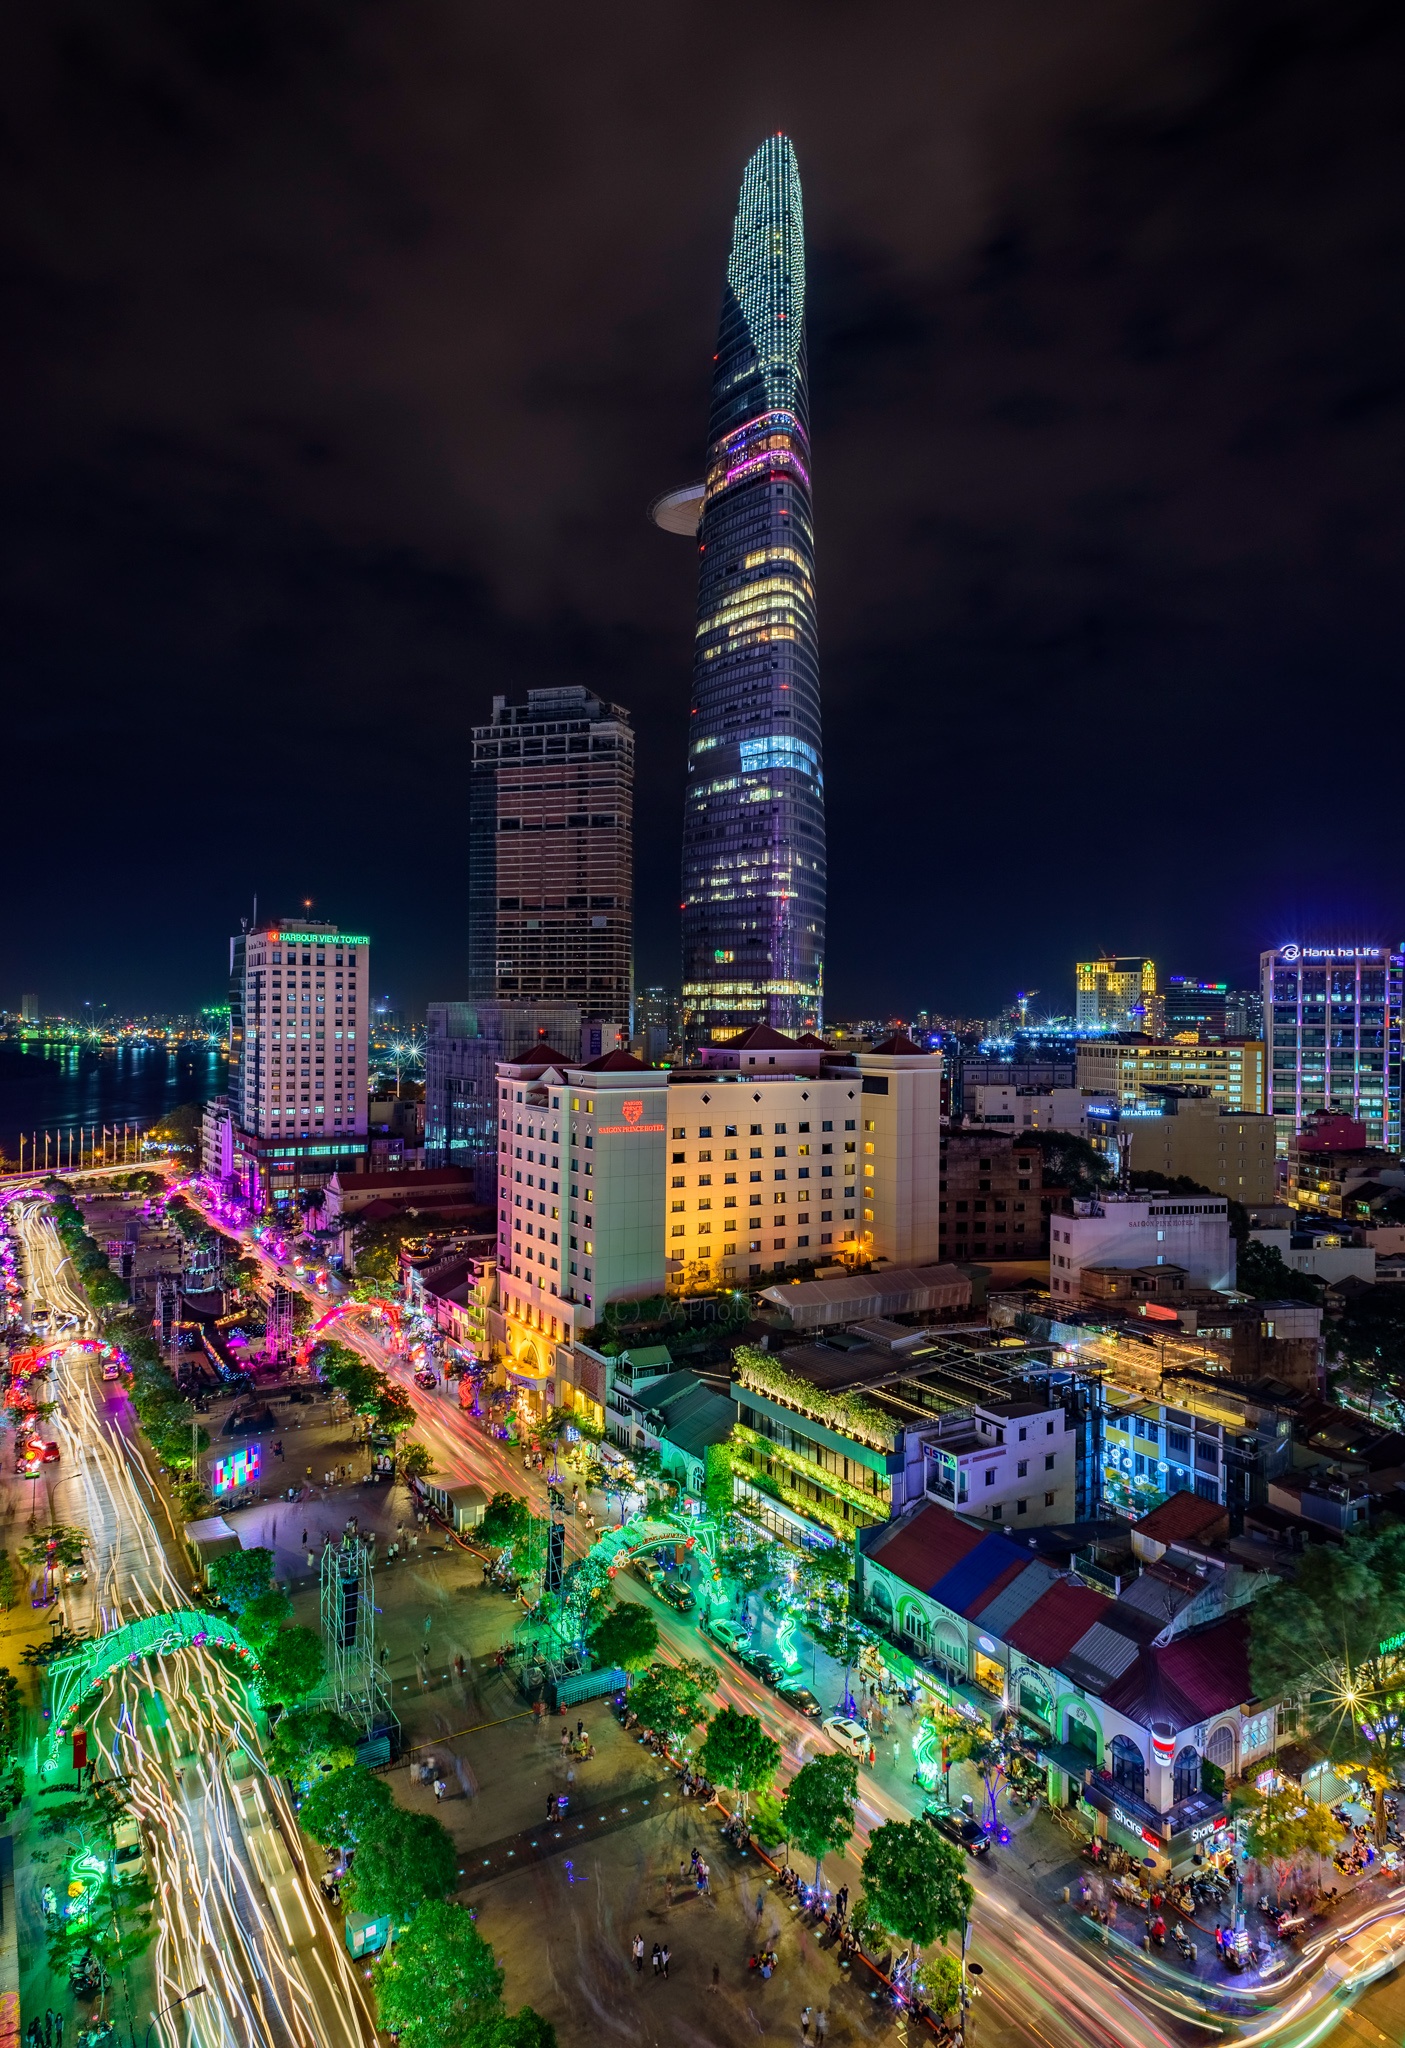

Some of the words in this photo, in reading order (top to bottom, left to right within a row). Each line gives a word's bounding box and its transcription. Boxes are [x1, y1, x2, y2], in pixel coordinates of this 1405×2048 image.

[279, 933, 318, 942] HARBOUR
[319, 935, 339, 943] VIEW
[340, 936, 369, 944] TOWER
[1355, 948, 1379, 956] Life
[598, 1126, 623, 1134] SAIGON
[622, 1125, 645, 1133] PRINCE
[644, 1124, 665, 1132] HOTEL
[1128, 1220, 1155, 1228] SAIGON
[1173, 1219, 1194, 1227] HOTEL
